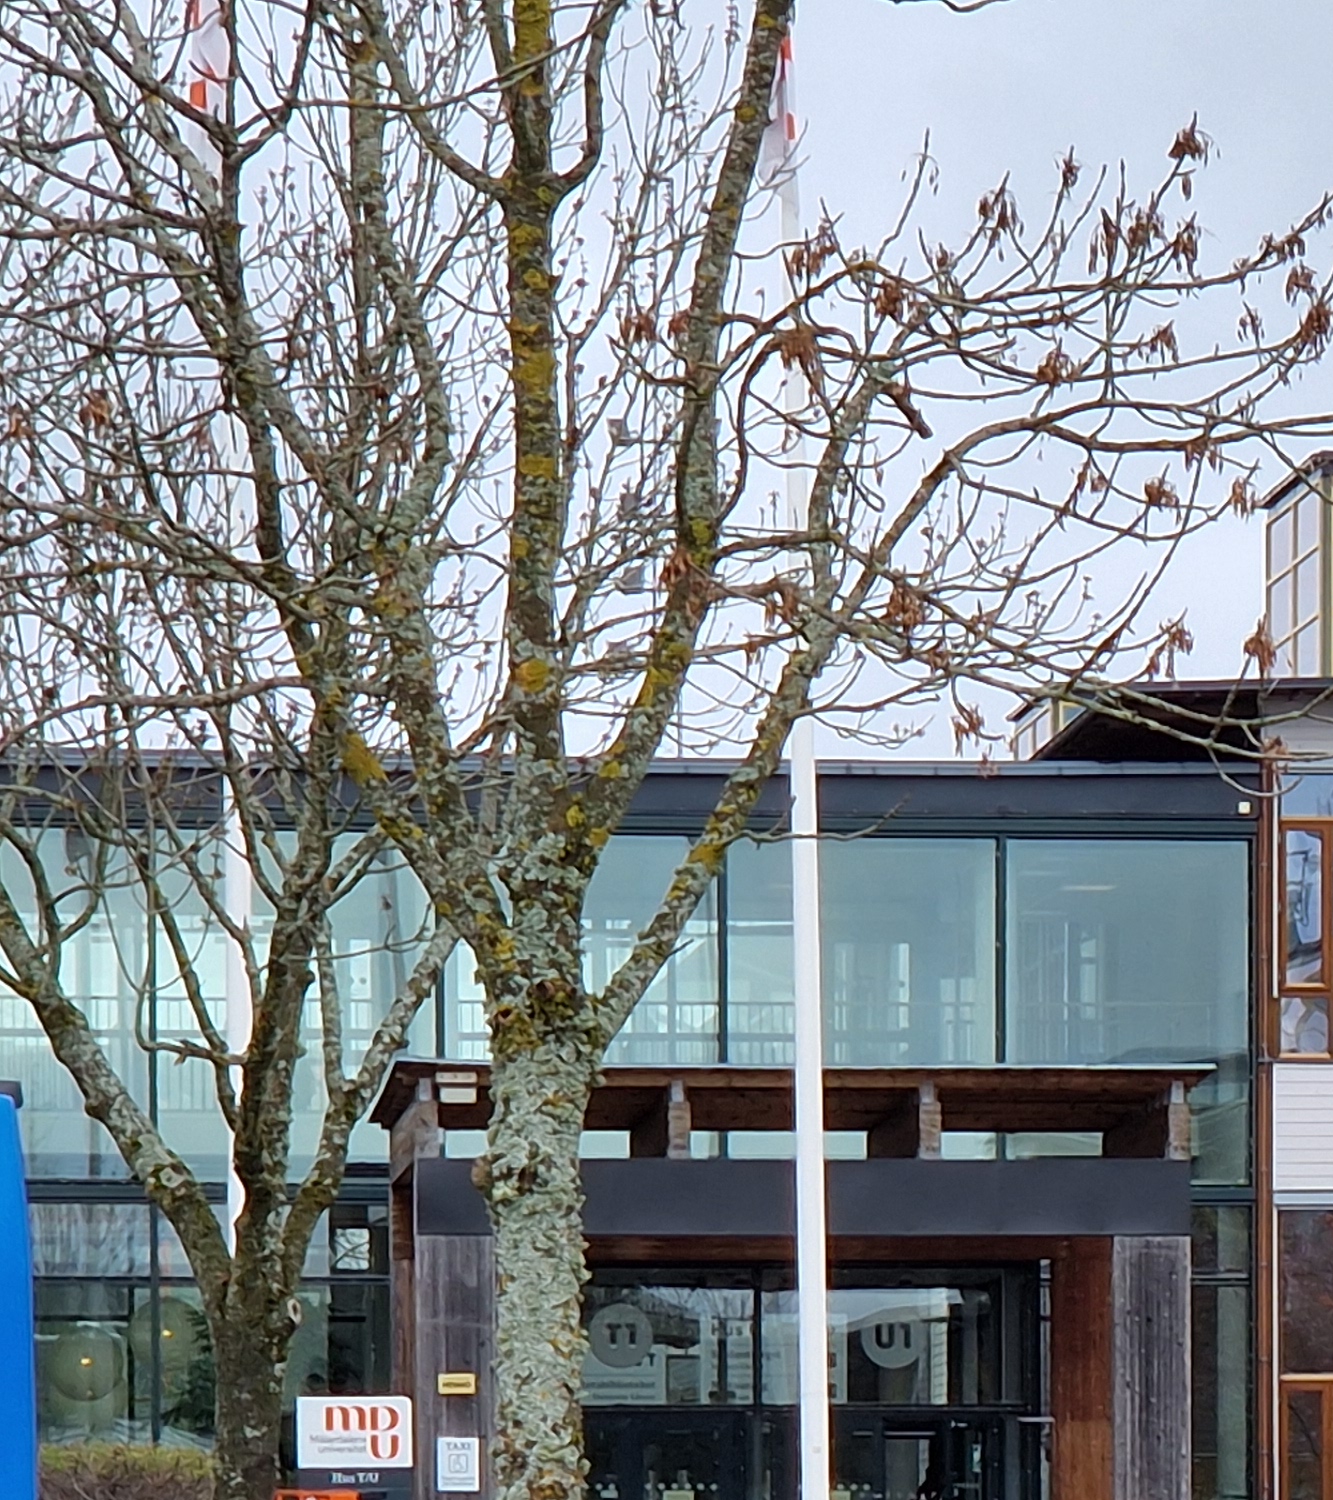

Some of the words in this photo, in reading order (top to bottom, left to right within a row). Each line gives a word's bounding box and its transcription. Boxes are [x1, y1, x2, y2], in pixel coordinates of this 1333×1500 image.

[445, 1442, 472, 1450] TAXI
[331, 1472, 355, 1484] Hus
[357, 1472, 379, 1484] T/U
